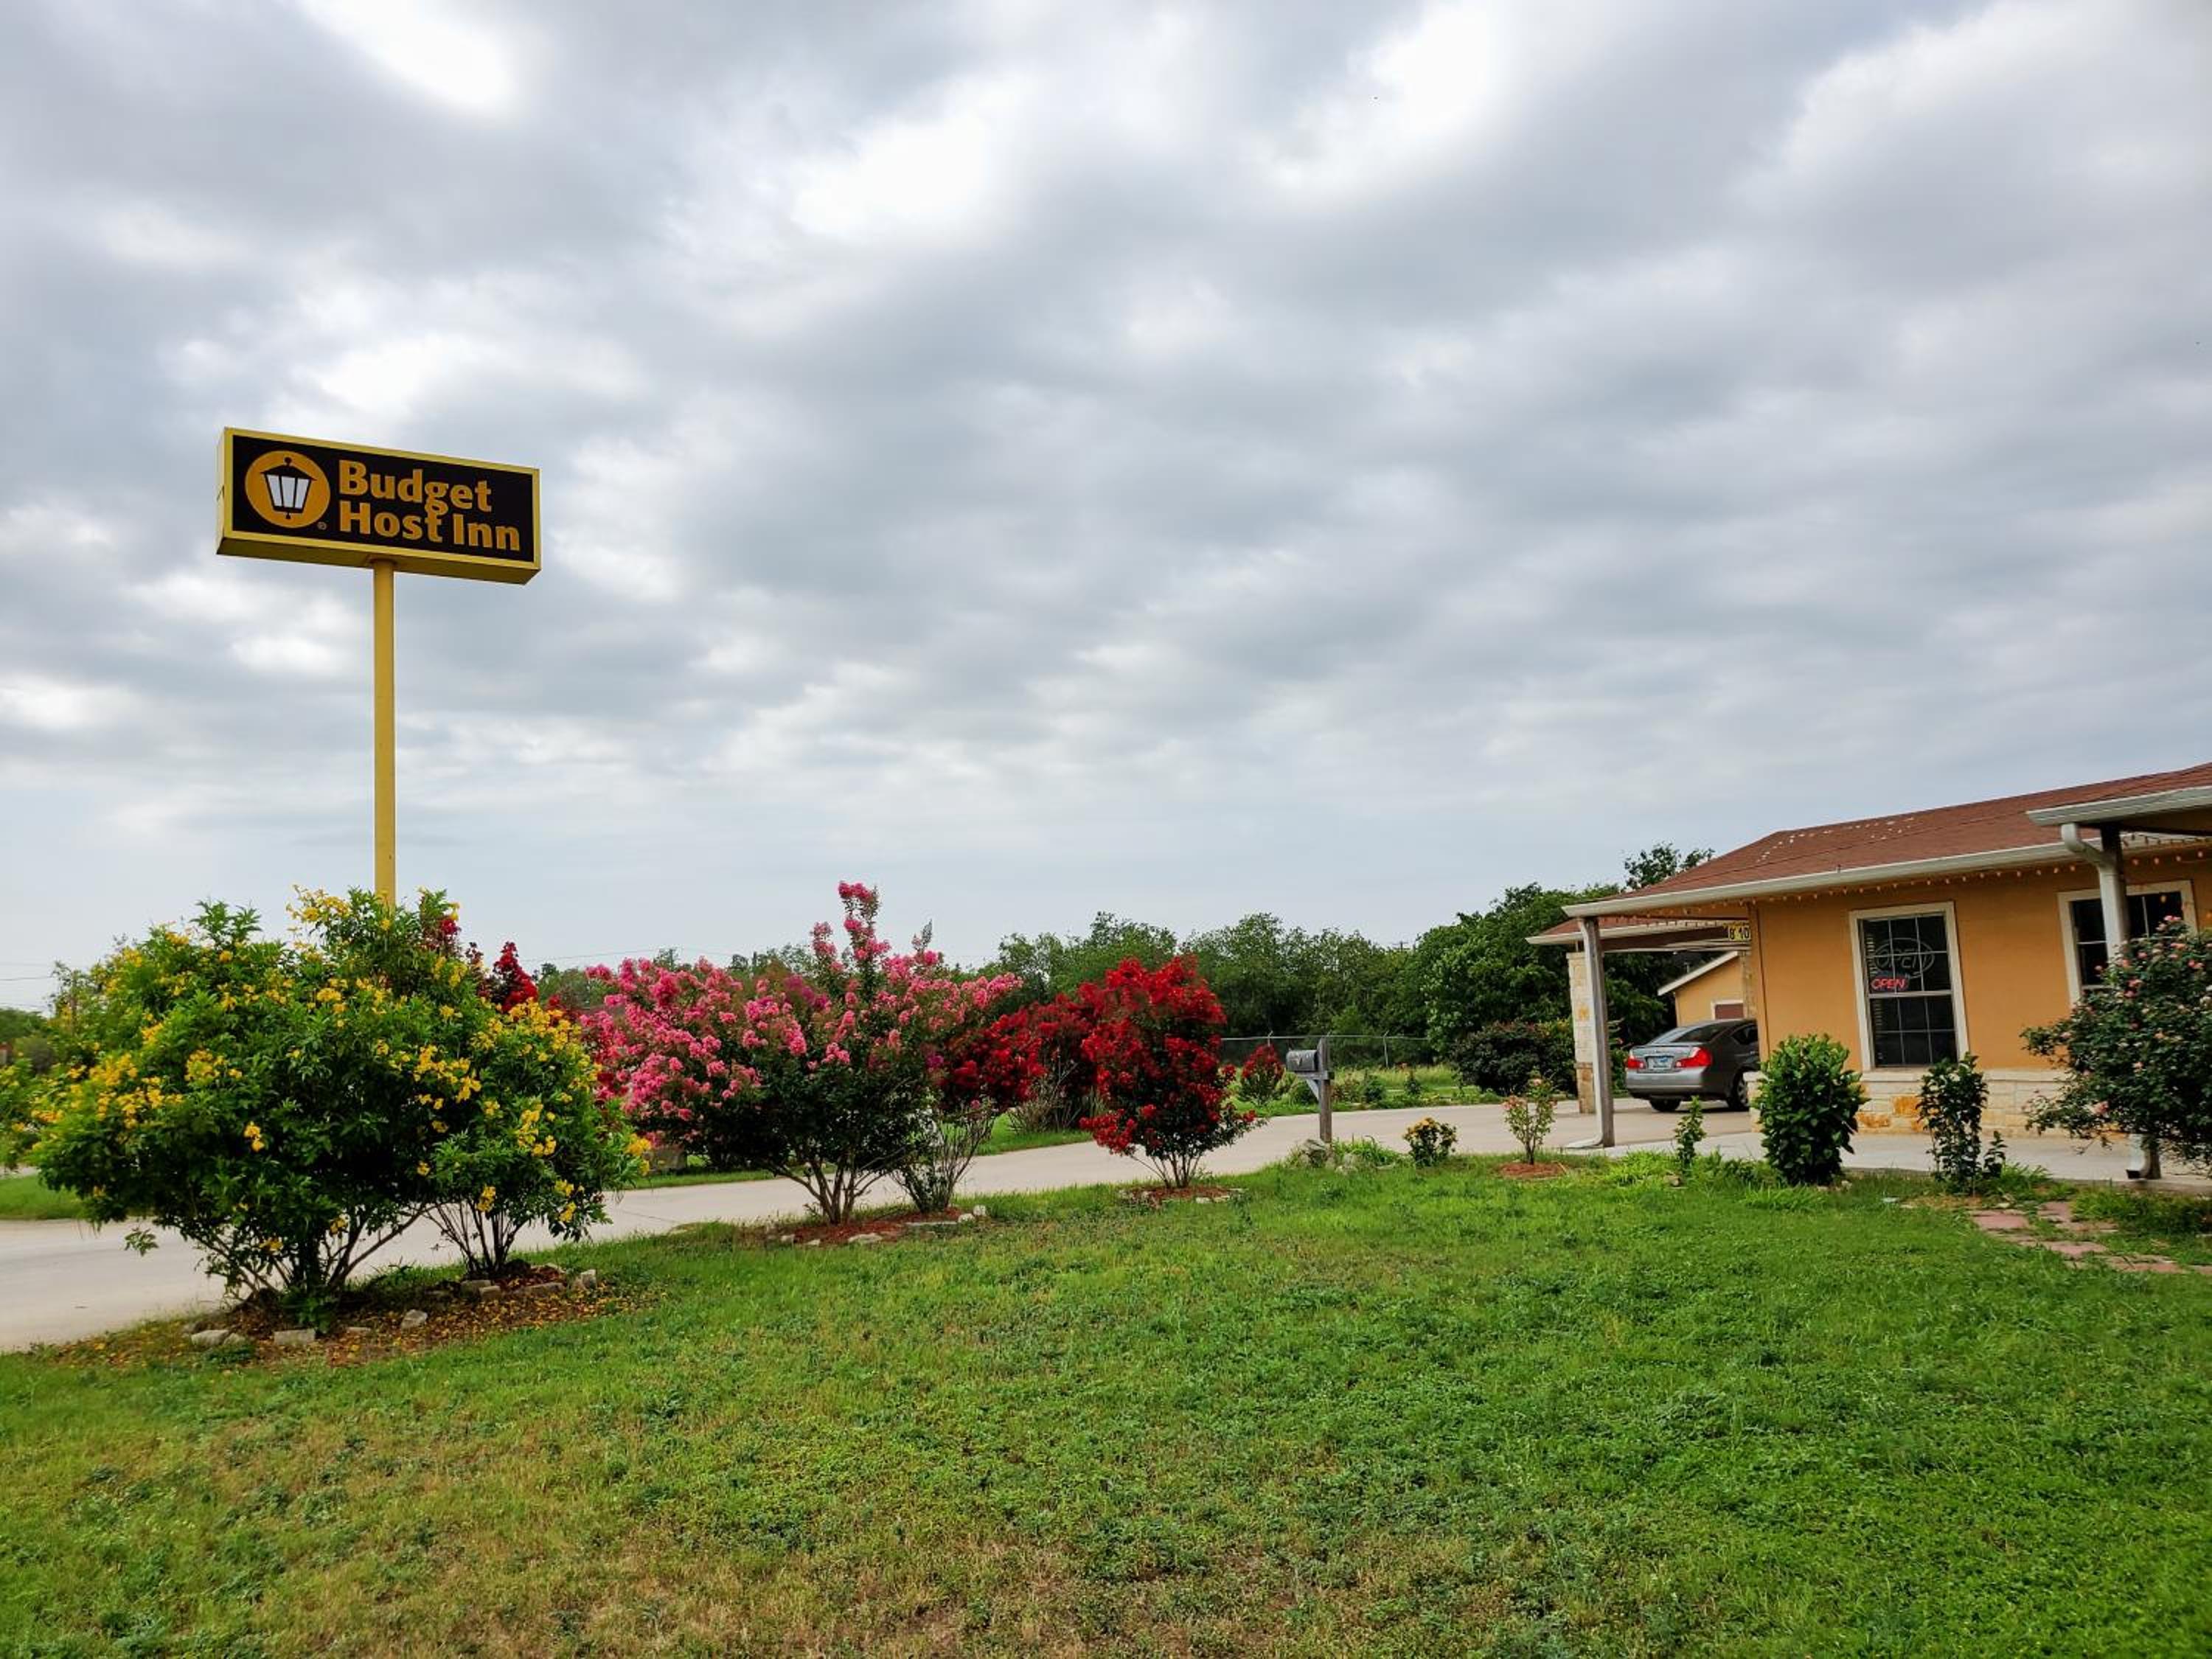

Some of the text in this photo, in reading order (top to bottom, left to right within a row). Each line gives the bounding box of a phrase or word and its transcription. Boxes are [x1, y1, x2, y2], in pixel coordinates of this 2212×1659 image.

[338, 459, 492, 515] Budget
[339, 500, 521, 552] Host Inn
[1877, 947, 1927, 968] OPEN
[1871, 978, 1906, 990] OPEN
